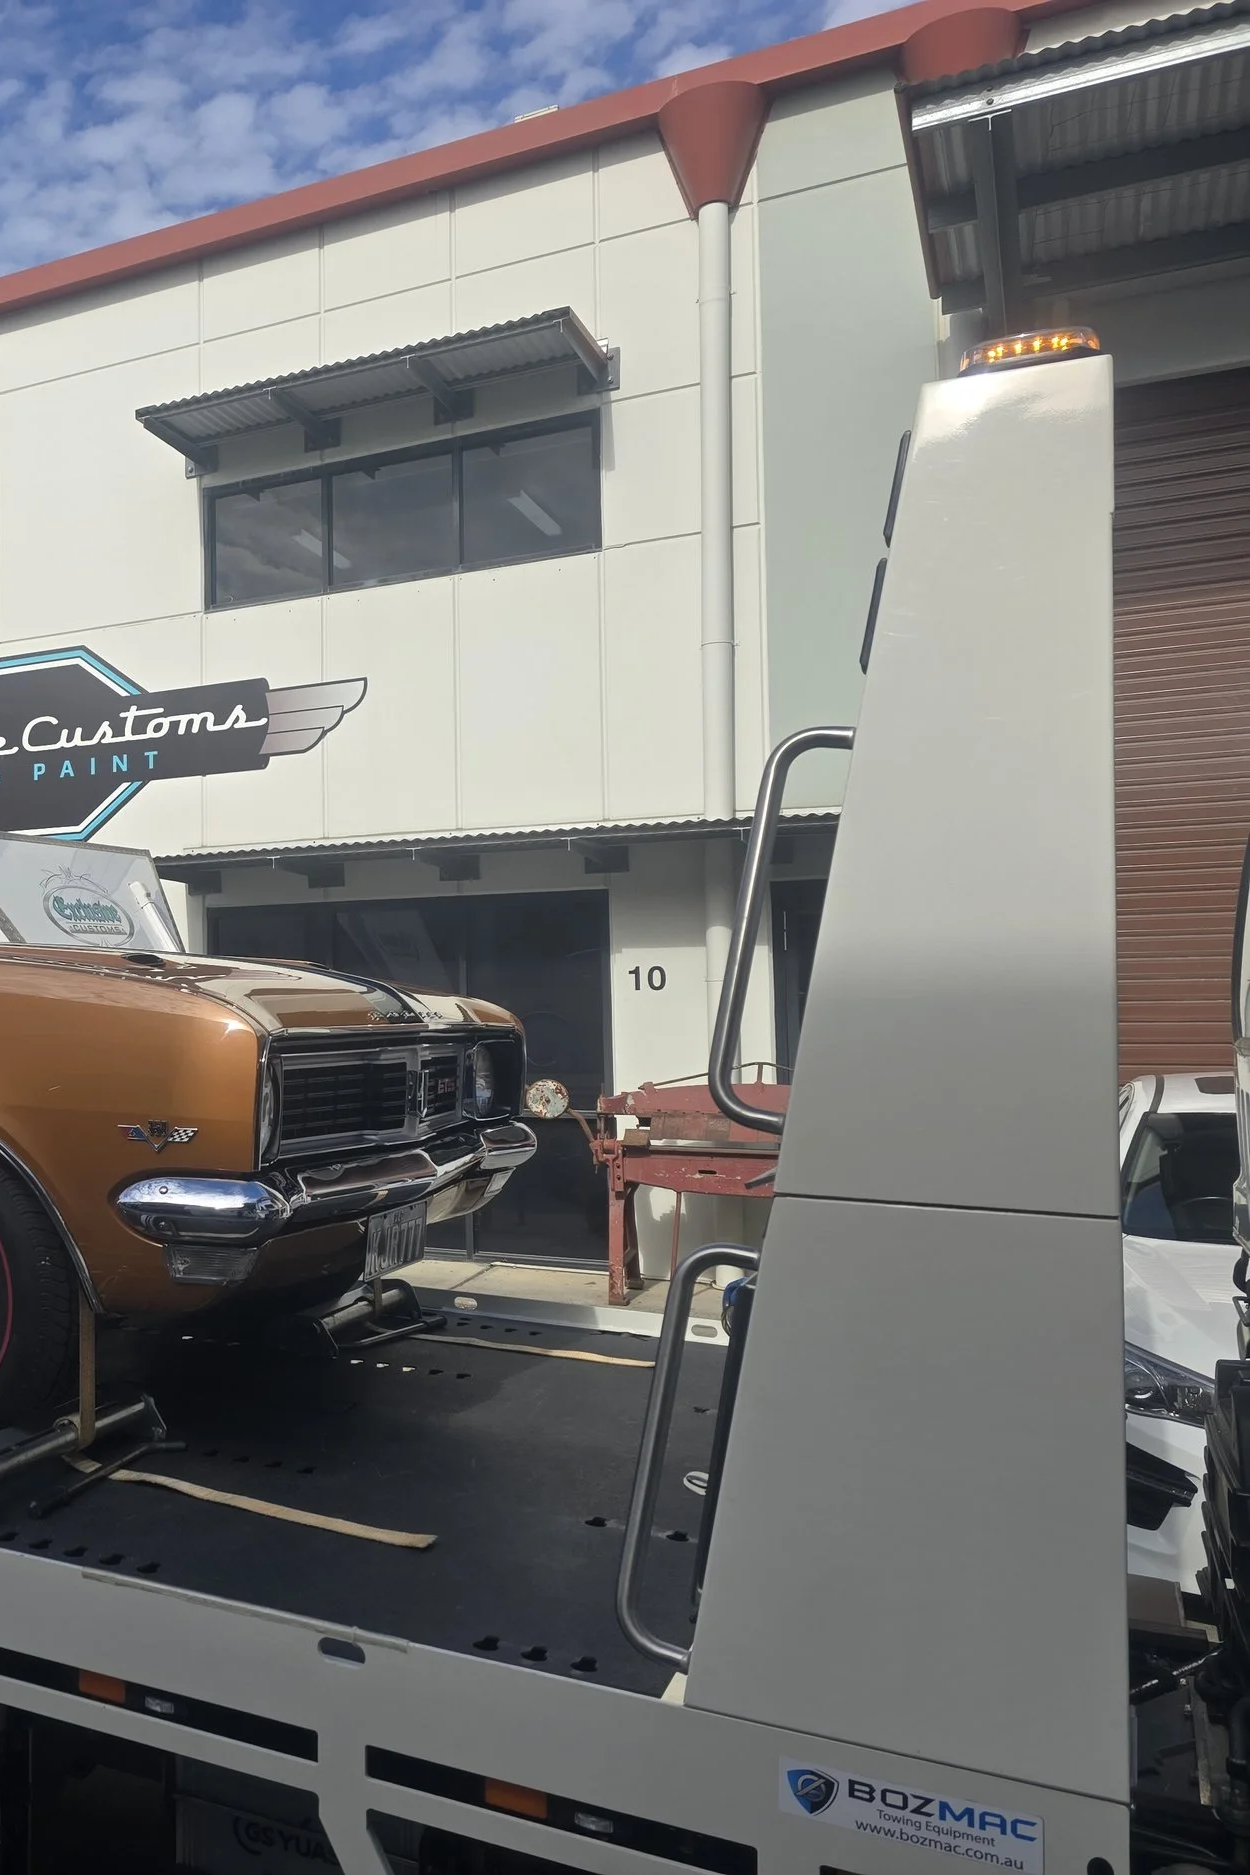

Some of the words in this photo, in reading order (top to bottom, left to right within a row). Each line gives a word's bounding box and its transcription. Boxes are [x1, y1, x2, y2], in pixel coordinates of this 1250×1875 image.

[21, 704, 268, 752] Customs
[33, 751, 158, 781] PAINT
[72, 924, 122, 934] CUSTOMS
[629, 966, 666, 990] 10
[848, 1778, 1037, 1842] BOZMAC
[877, 1809, 922, 1831] Towing
[925, 1821, 996, 1848] Equipment
[855, 1819, 1024, 1870] www.bozmac.com.au
